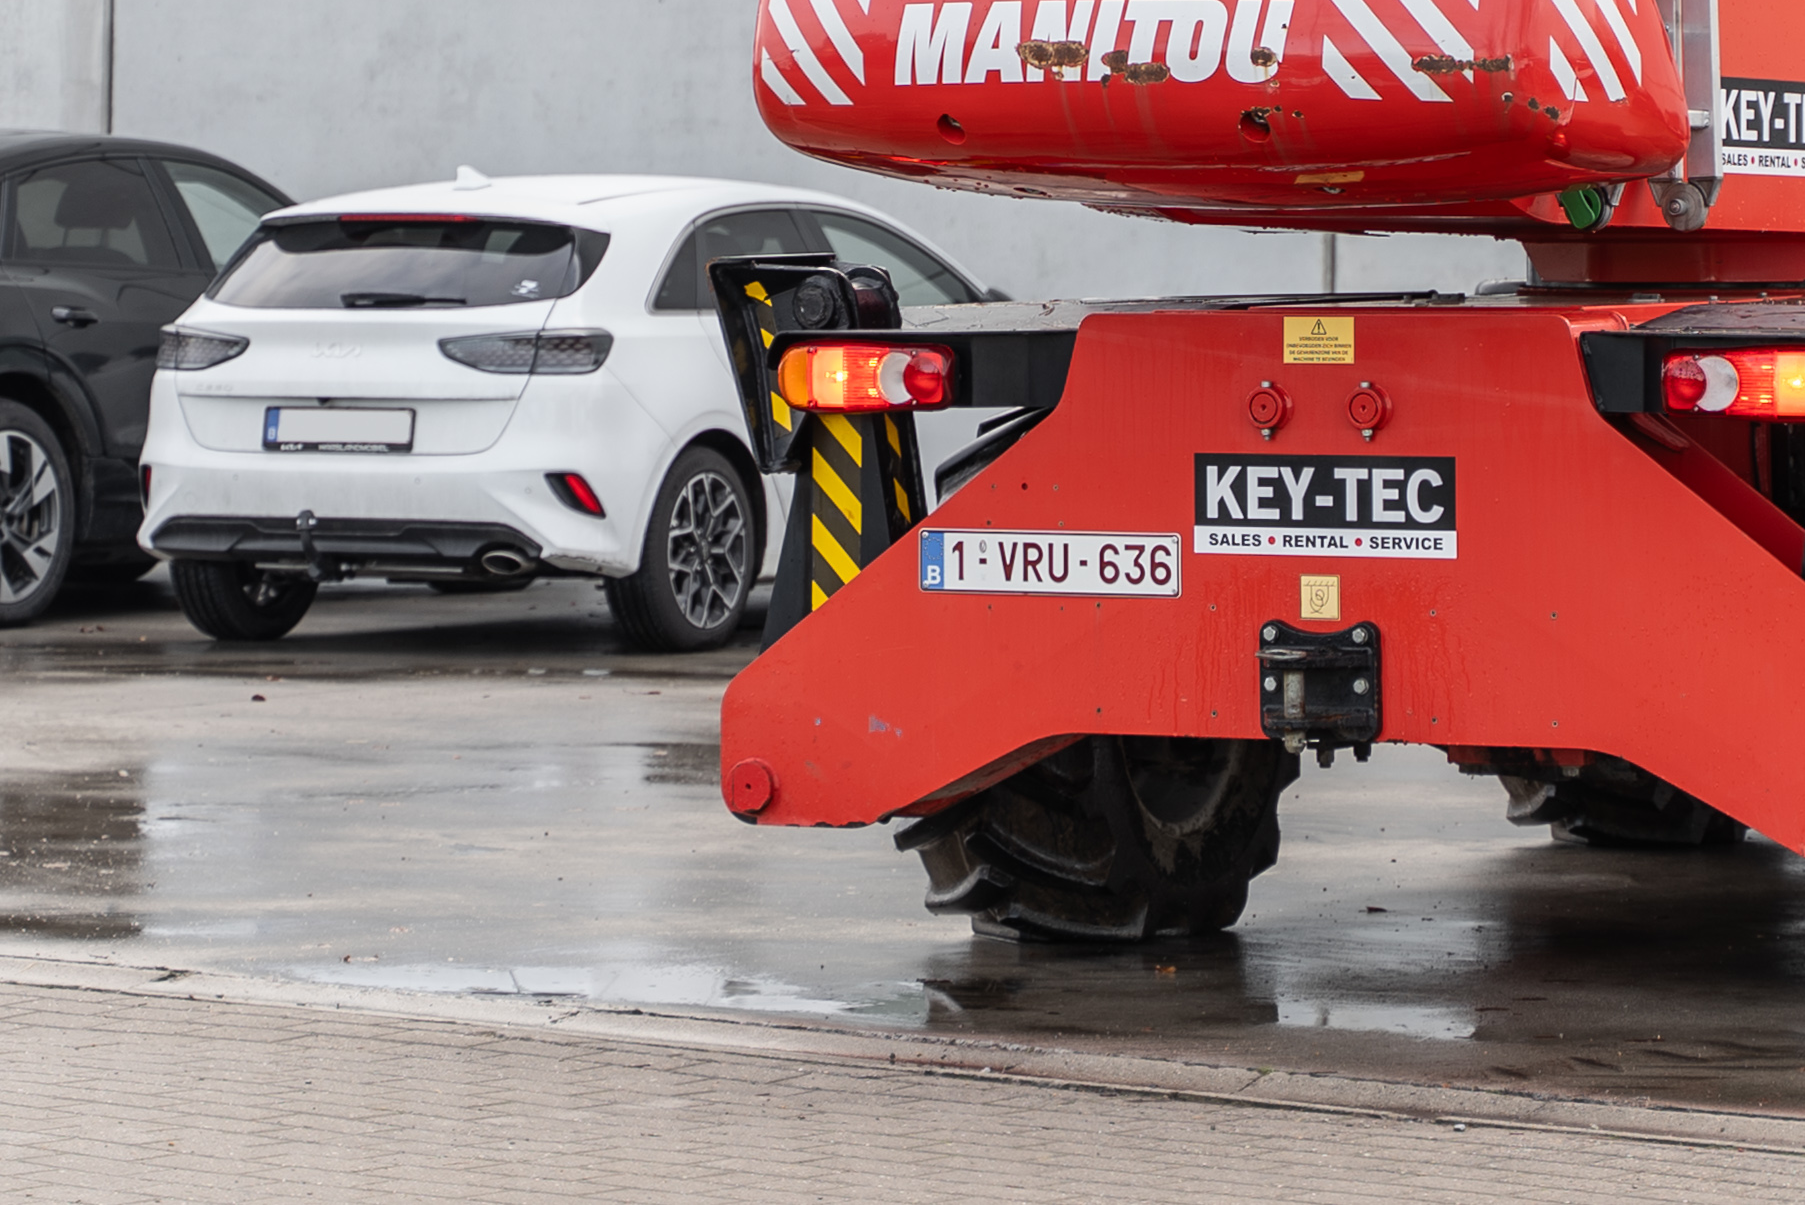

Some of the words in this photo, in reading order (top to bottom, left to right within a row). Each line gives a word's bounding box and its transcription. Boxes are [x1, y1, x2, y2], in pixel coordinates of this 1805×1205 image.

[1722, 153, 1749, 167] SALES
[1758, 155, 1792, 169] RENTAL
[1206, 465, 1445, 525] KEY-TEC
[1208, 532, 1262, 547] SALES
[1282, 534, 1349, 549] RENTAL
[1368, 536, 1444, 551] SERVICE
[927, 564, 942, 585] B
[952, 540, 1173, 586] 1-VRU-636
